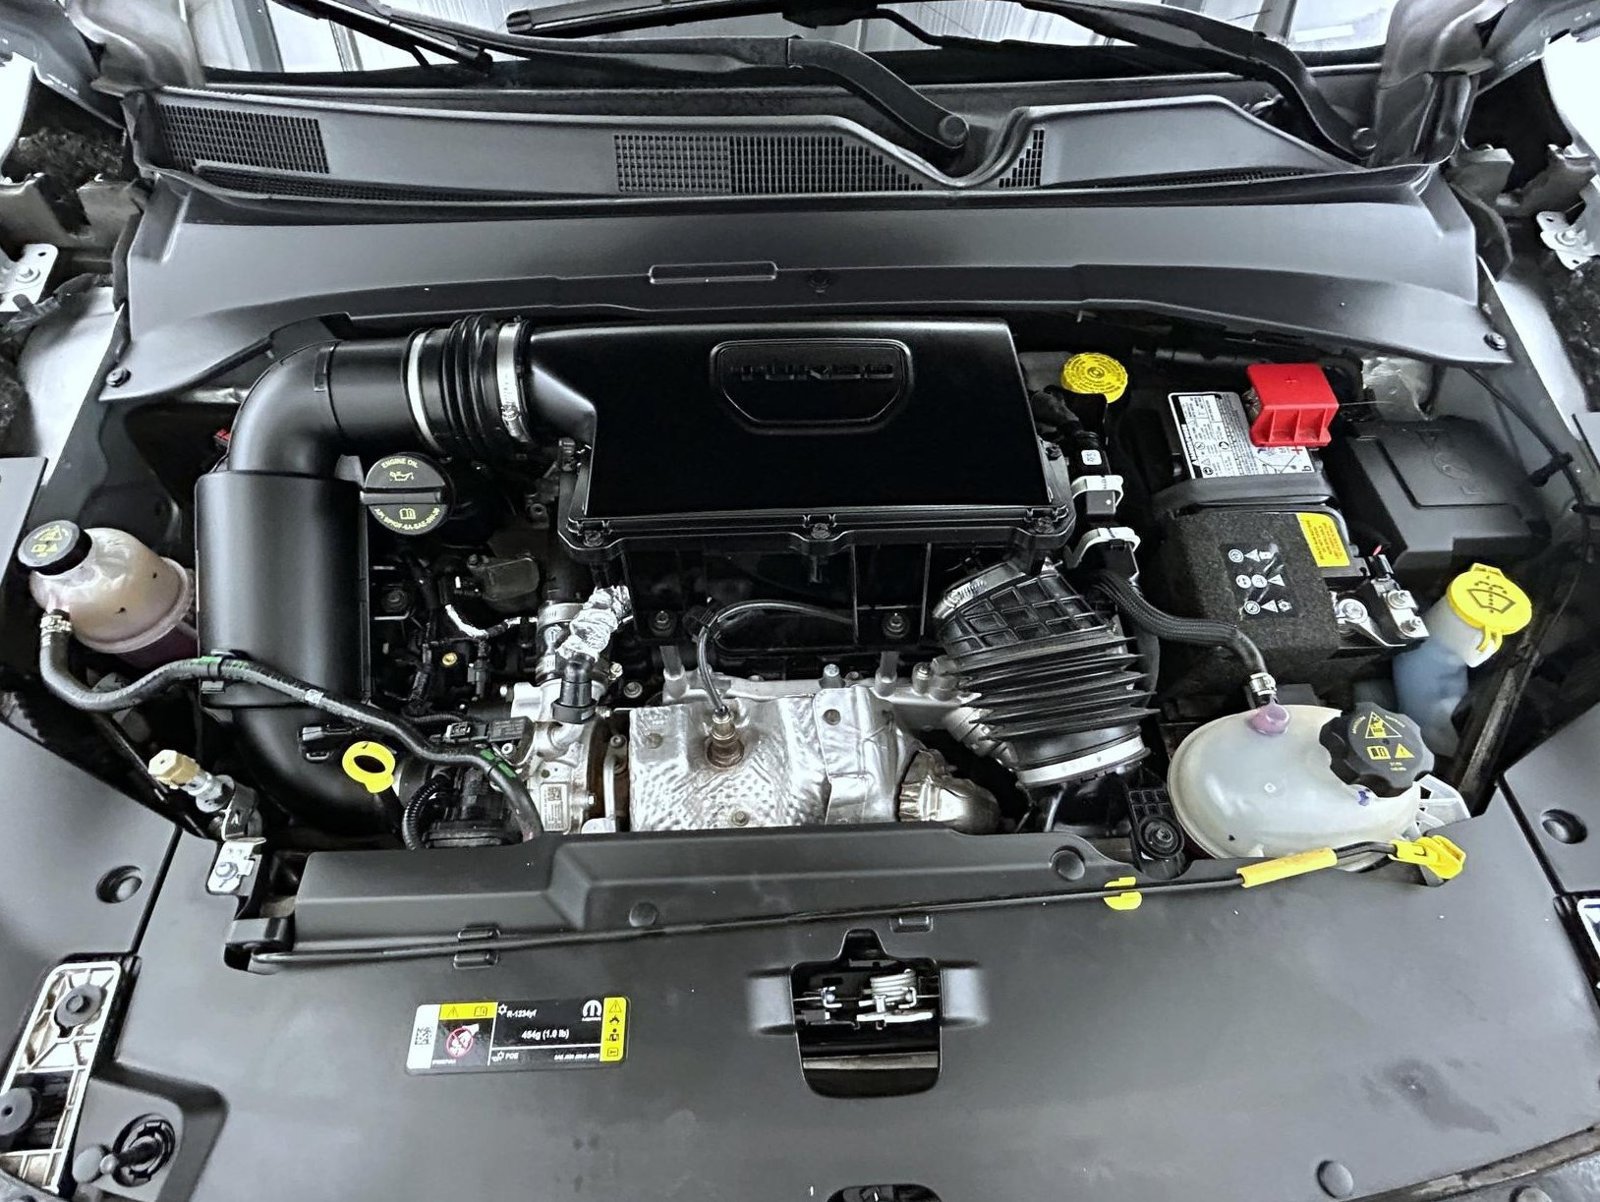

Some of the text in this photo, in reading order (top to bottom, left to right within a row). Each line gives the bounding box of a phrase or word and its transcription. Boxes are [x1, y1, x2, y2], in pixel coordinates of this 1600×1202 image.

[381, 458, 418, 468] ENGINE OIL
[506, 1008, 538, 1019] R-1234yf
[521, 1029, 541, 1040] 454g
[558, 1028, 570, 1040] lb)
